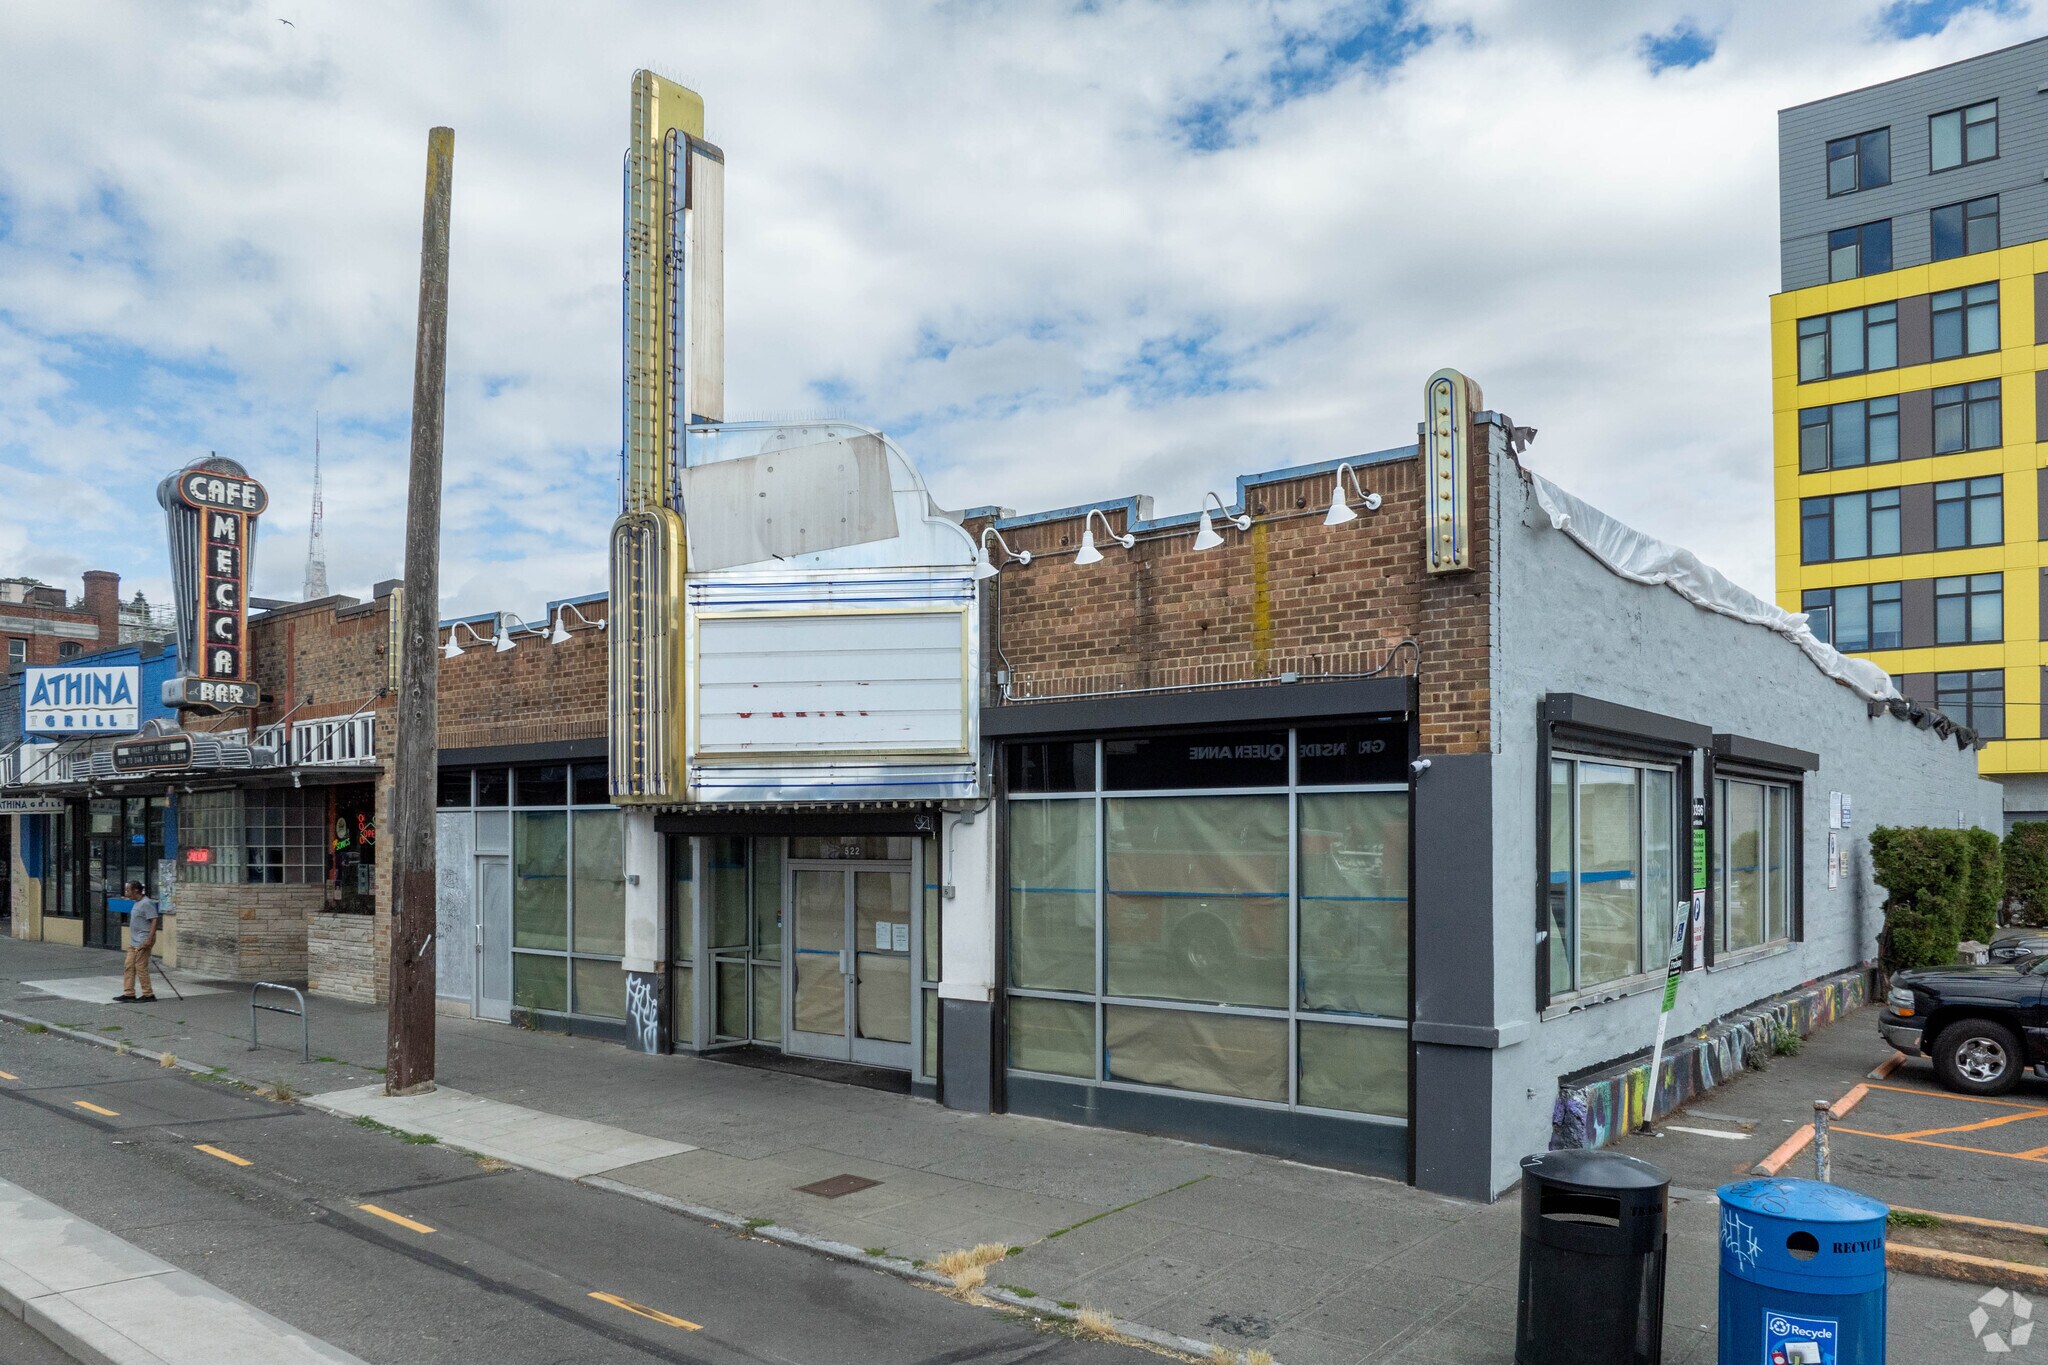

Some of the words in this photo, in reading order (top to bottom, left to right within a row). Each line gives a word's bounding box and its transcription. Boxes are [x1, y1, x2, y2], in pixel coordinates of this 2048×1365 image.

[212, 515, 236, 674] MECCA
[30, 671, 133, 706] ATHINA
[200, 682, 244, 704] BAR
[45, 714, 117, 727] GRILL
[844, 847, 860, 856] 522
[1833, 1237, 1882, 1254] RECYCLE
[1791, 1325, 1833, 1339] Recycle
